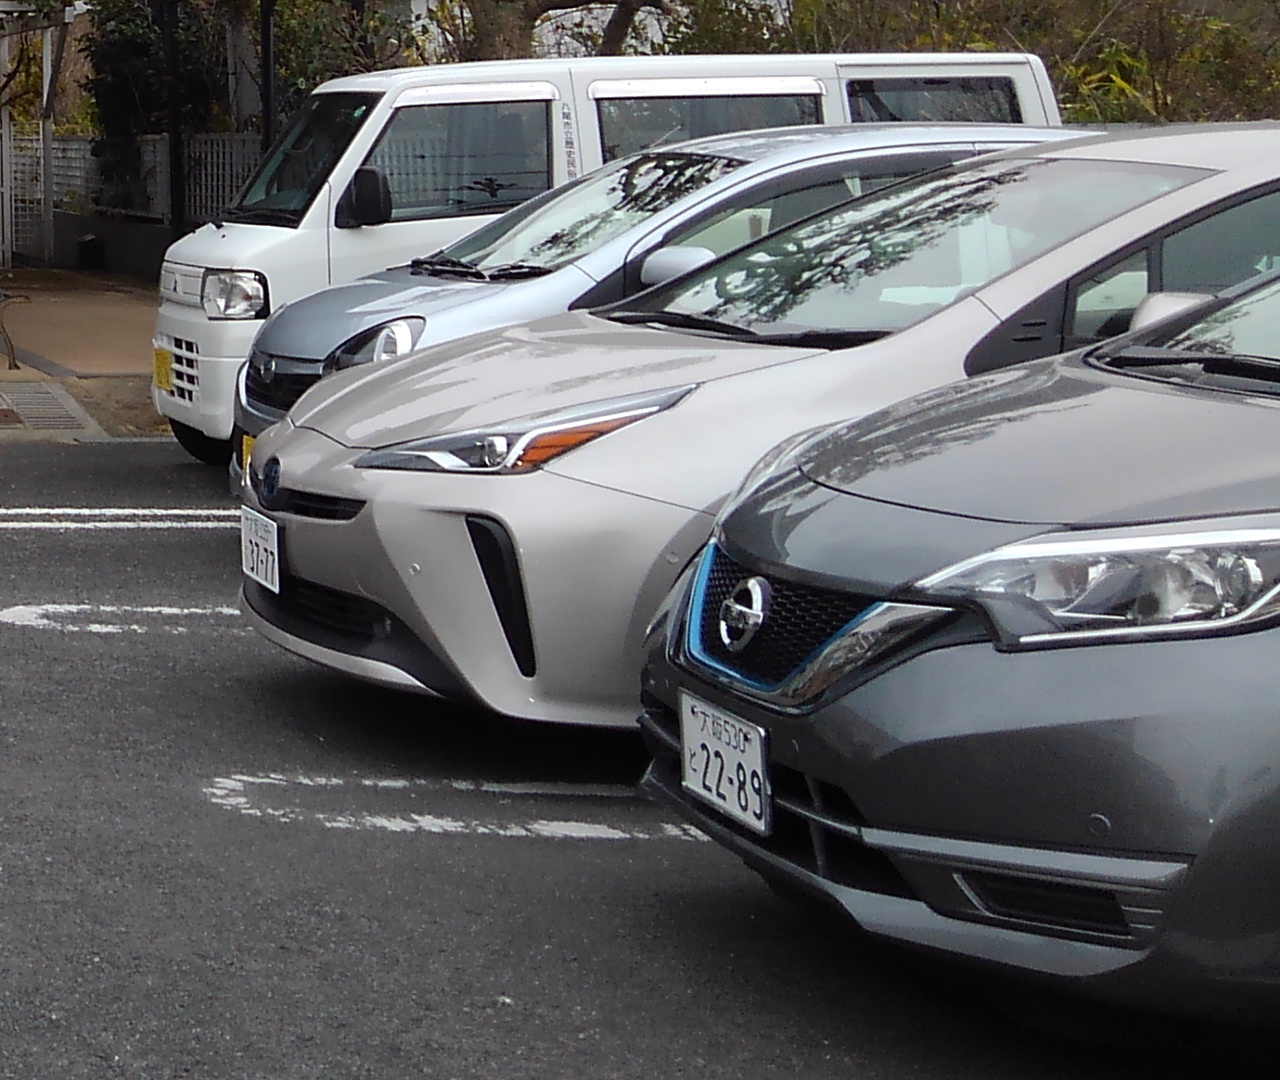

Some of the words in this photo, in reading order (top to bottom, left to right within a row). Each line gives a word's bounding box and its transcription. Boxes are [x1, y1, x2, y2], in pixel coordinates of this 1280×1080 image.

[561, 102, 578, 181] 八尾市立歴史民俗
[700, 742, 764, 821] 22-89
